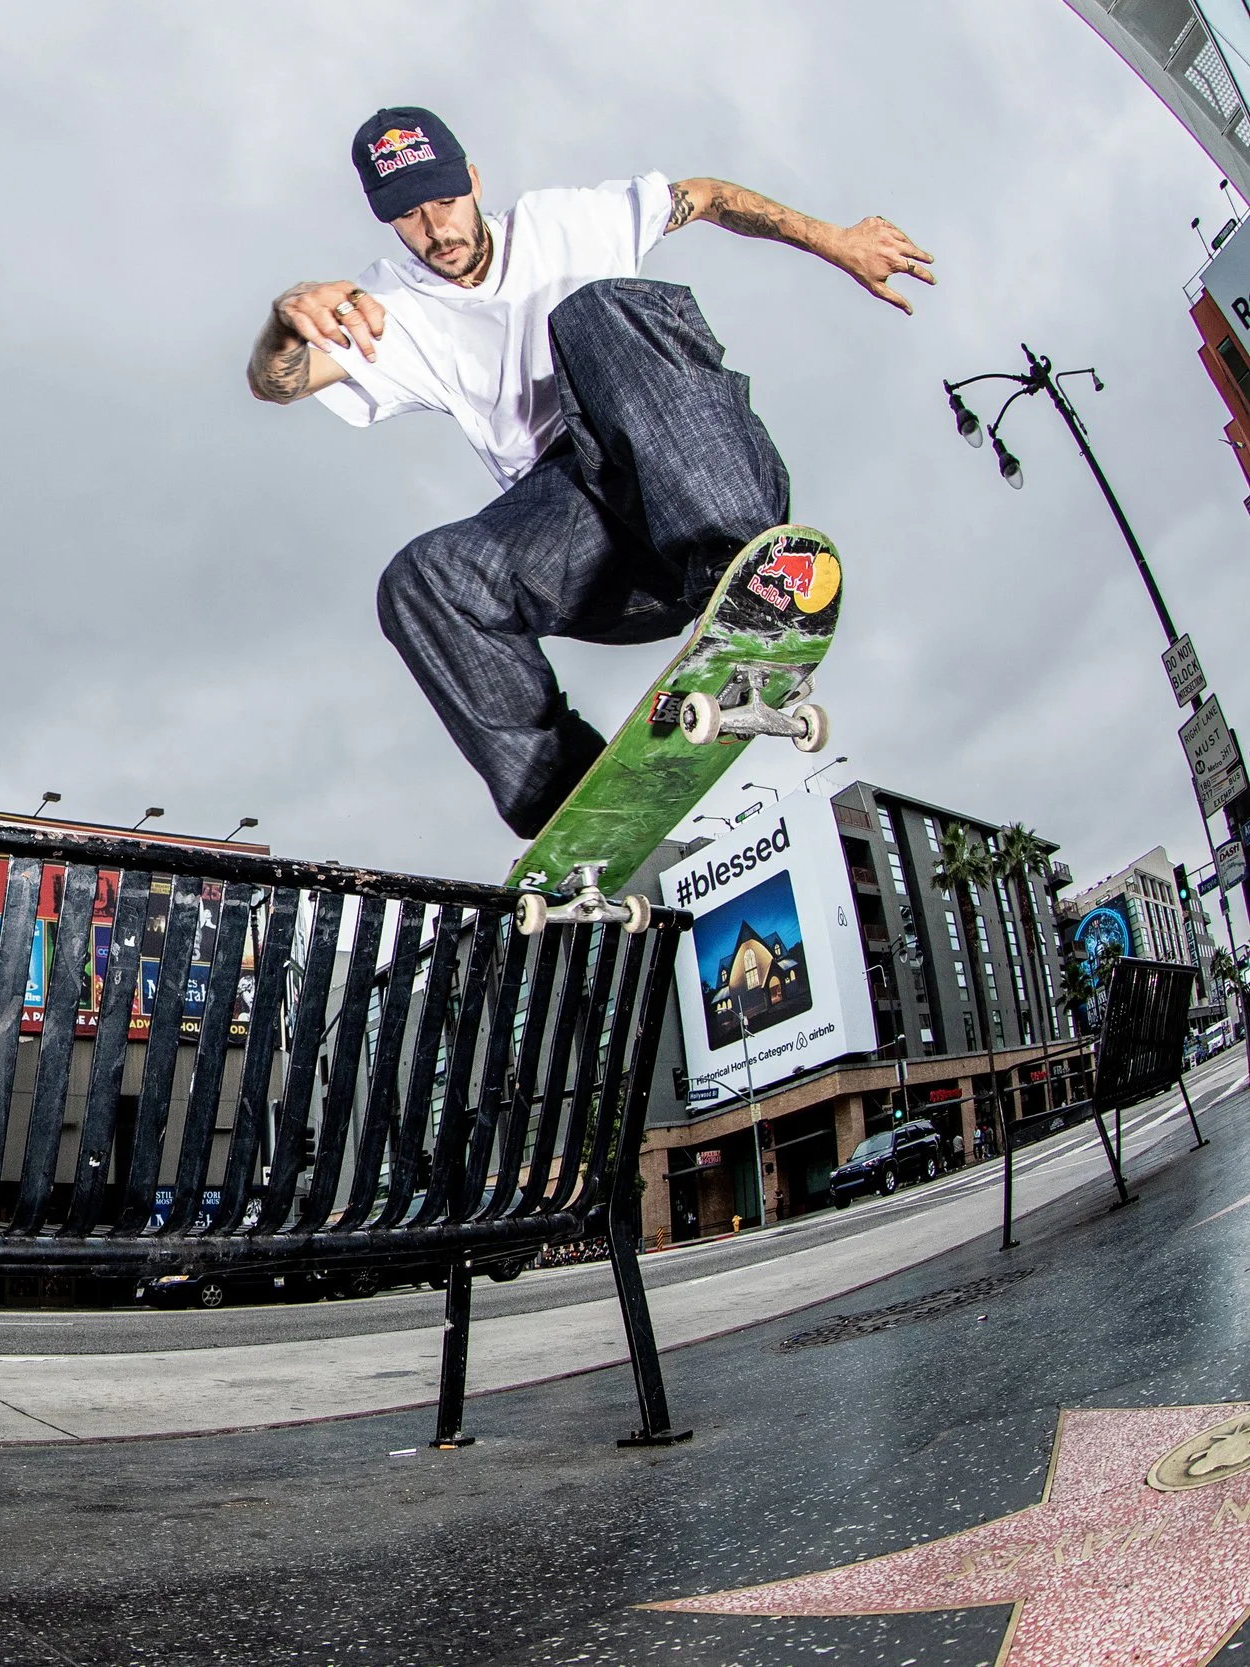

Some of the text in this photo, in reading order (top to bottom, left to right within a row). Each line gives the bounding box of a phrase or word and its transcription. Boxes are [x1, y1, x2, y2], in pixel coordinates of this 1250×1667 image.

[375, 144, 436, 177] Red Bull
[1165, 641, 1193, 672] DO NOT
[1171, 659, 1199, 689] BLOCK
[1183, 705, 1218, 744] RIGHT LANE
[1194, 728, 1221, 758] MUST
[1207, 760, 1222, 773] Metro
[1228, 771, 1241, 785] BUS
[1213, 785, 1236, 807] EXEMPT
[676, 816, 791, 908] #blessed
[1219, 843, 1240, 862] DASH
[695, 1022, 835, 1086] Historical Homes Category airbnb
[690, 1089, 712, 1099] Hollywood
